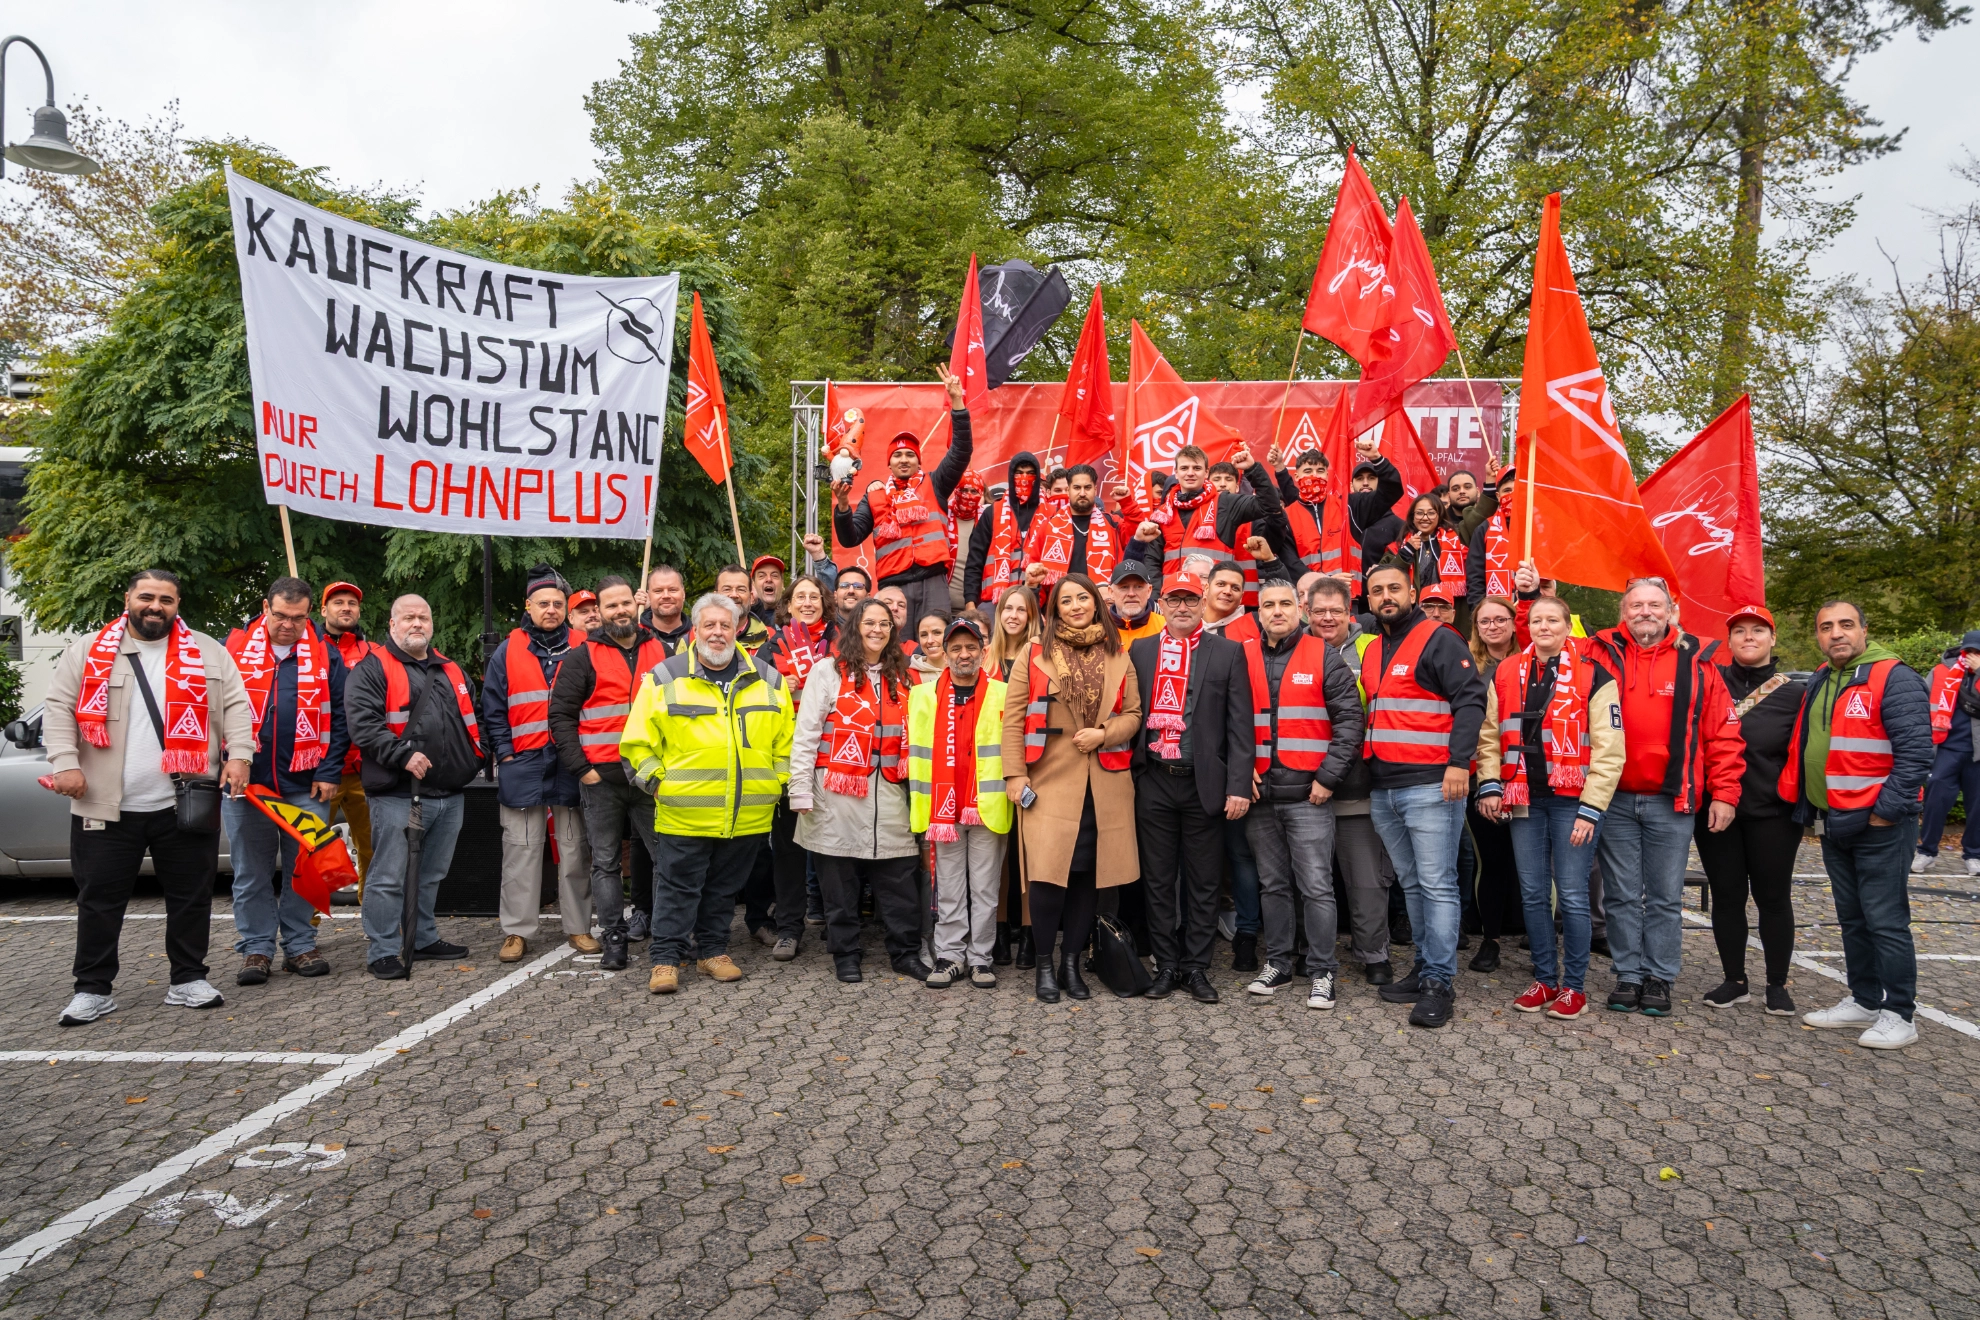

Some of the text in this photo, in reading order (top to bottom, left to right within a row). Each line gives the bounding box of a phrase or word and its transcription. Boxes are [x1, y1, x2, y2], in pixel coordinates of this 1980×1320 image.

[245, 197, 564, 328] KAUFKRAFT
[325, 298, 600, 396] WACHSTUM
[262, 401, 318, 450] NUR
[378, 385, 660, 466] WOHLSTAND
[265, 452, 359, 504] DURCH
[373, 454, 628, 525] LOHNPLUS
